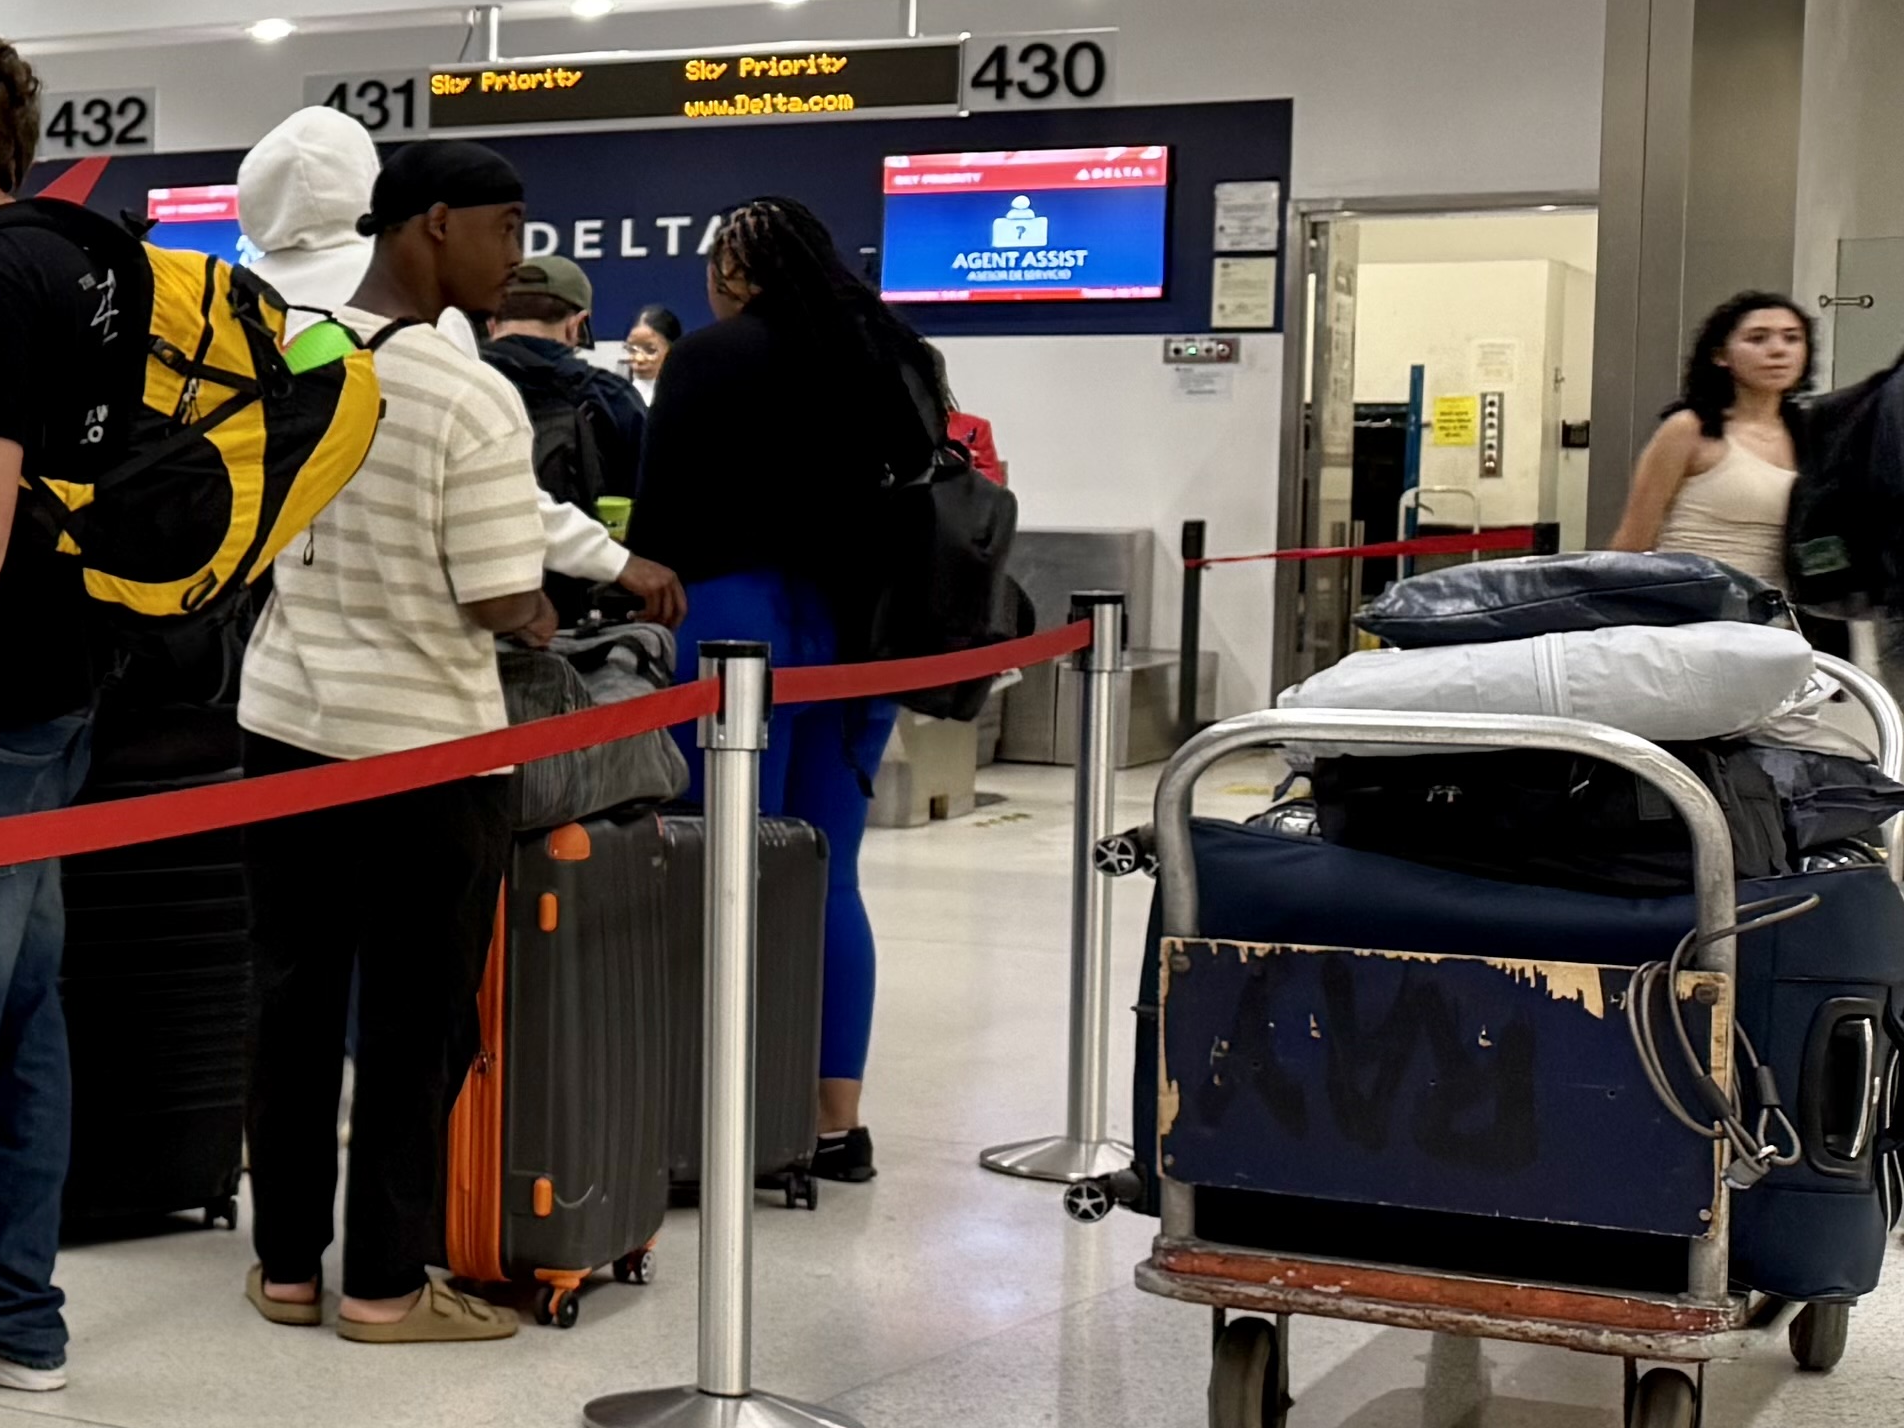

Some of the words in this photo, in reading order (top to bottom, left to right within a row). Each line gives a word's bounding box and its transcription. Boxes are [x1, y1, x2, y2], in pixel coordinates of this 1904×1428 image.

[430, 74, 472, 95] Sky
[481, 67, 582, 93] Priority
[685, 59, 727, 82] Sky
[740, 53, 847, 78] Priority
[970, 41, 1106, 100] 430
[684, 93, 854, 118] www.Delta.com
[47, 95, 146, 147] 432
[952, 251, 1019, 270] AGENT
[1021, 249, 1088, 268] ASSIST
